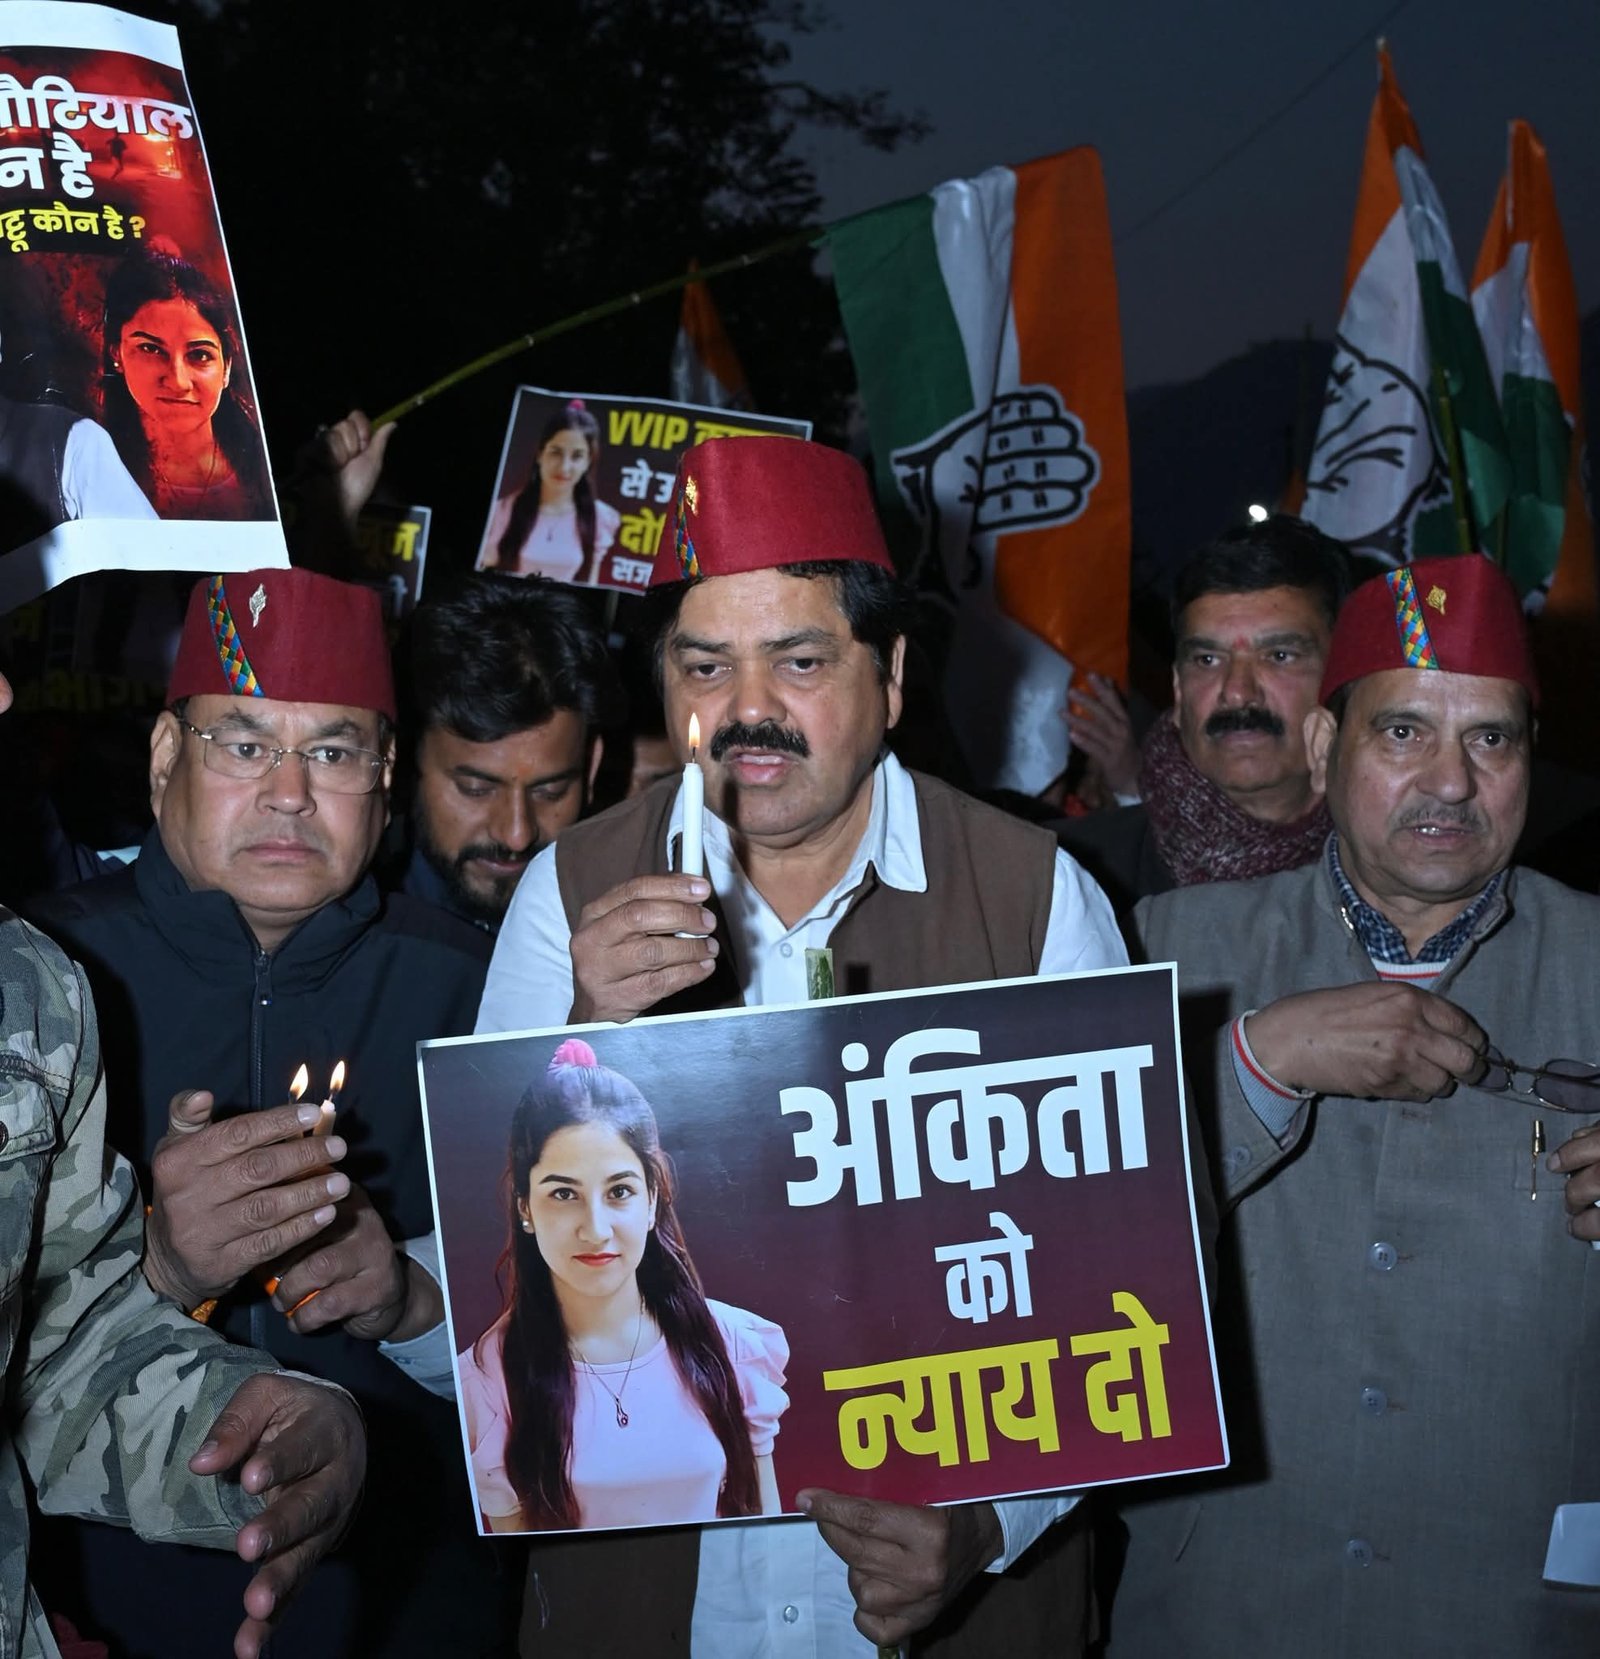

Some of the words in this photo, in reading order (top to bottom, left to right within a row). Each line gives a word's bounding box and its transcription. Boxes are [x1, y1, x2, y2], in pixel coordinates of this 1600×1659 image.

[51, 131, 95, 199] है
[29, 201, 99, 235] कौन
[608, 409, 690, 450] VVIP
[619, 457, 653, 500] से
[779, 1027, 1154, 1207] अंकिता
[934, 1211, 1034, 1324] को
[823, 1338, 1061, 1470] न्याय
[1070, 1291, 1172, 1443] दो
